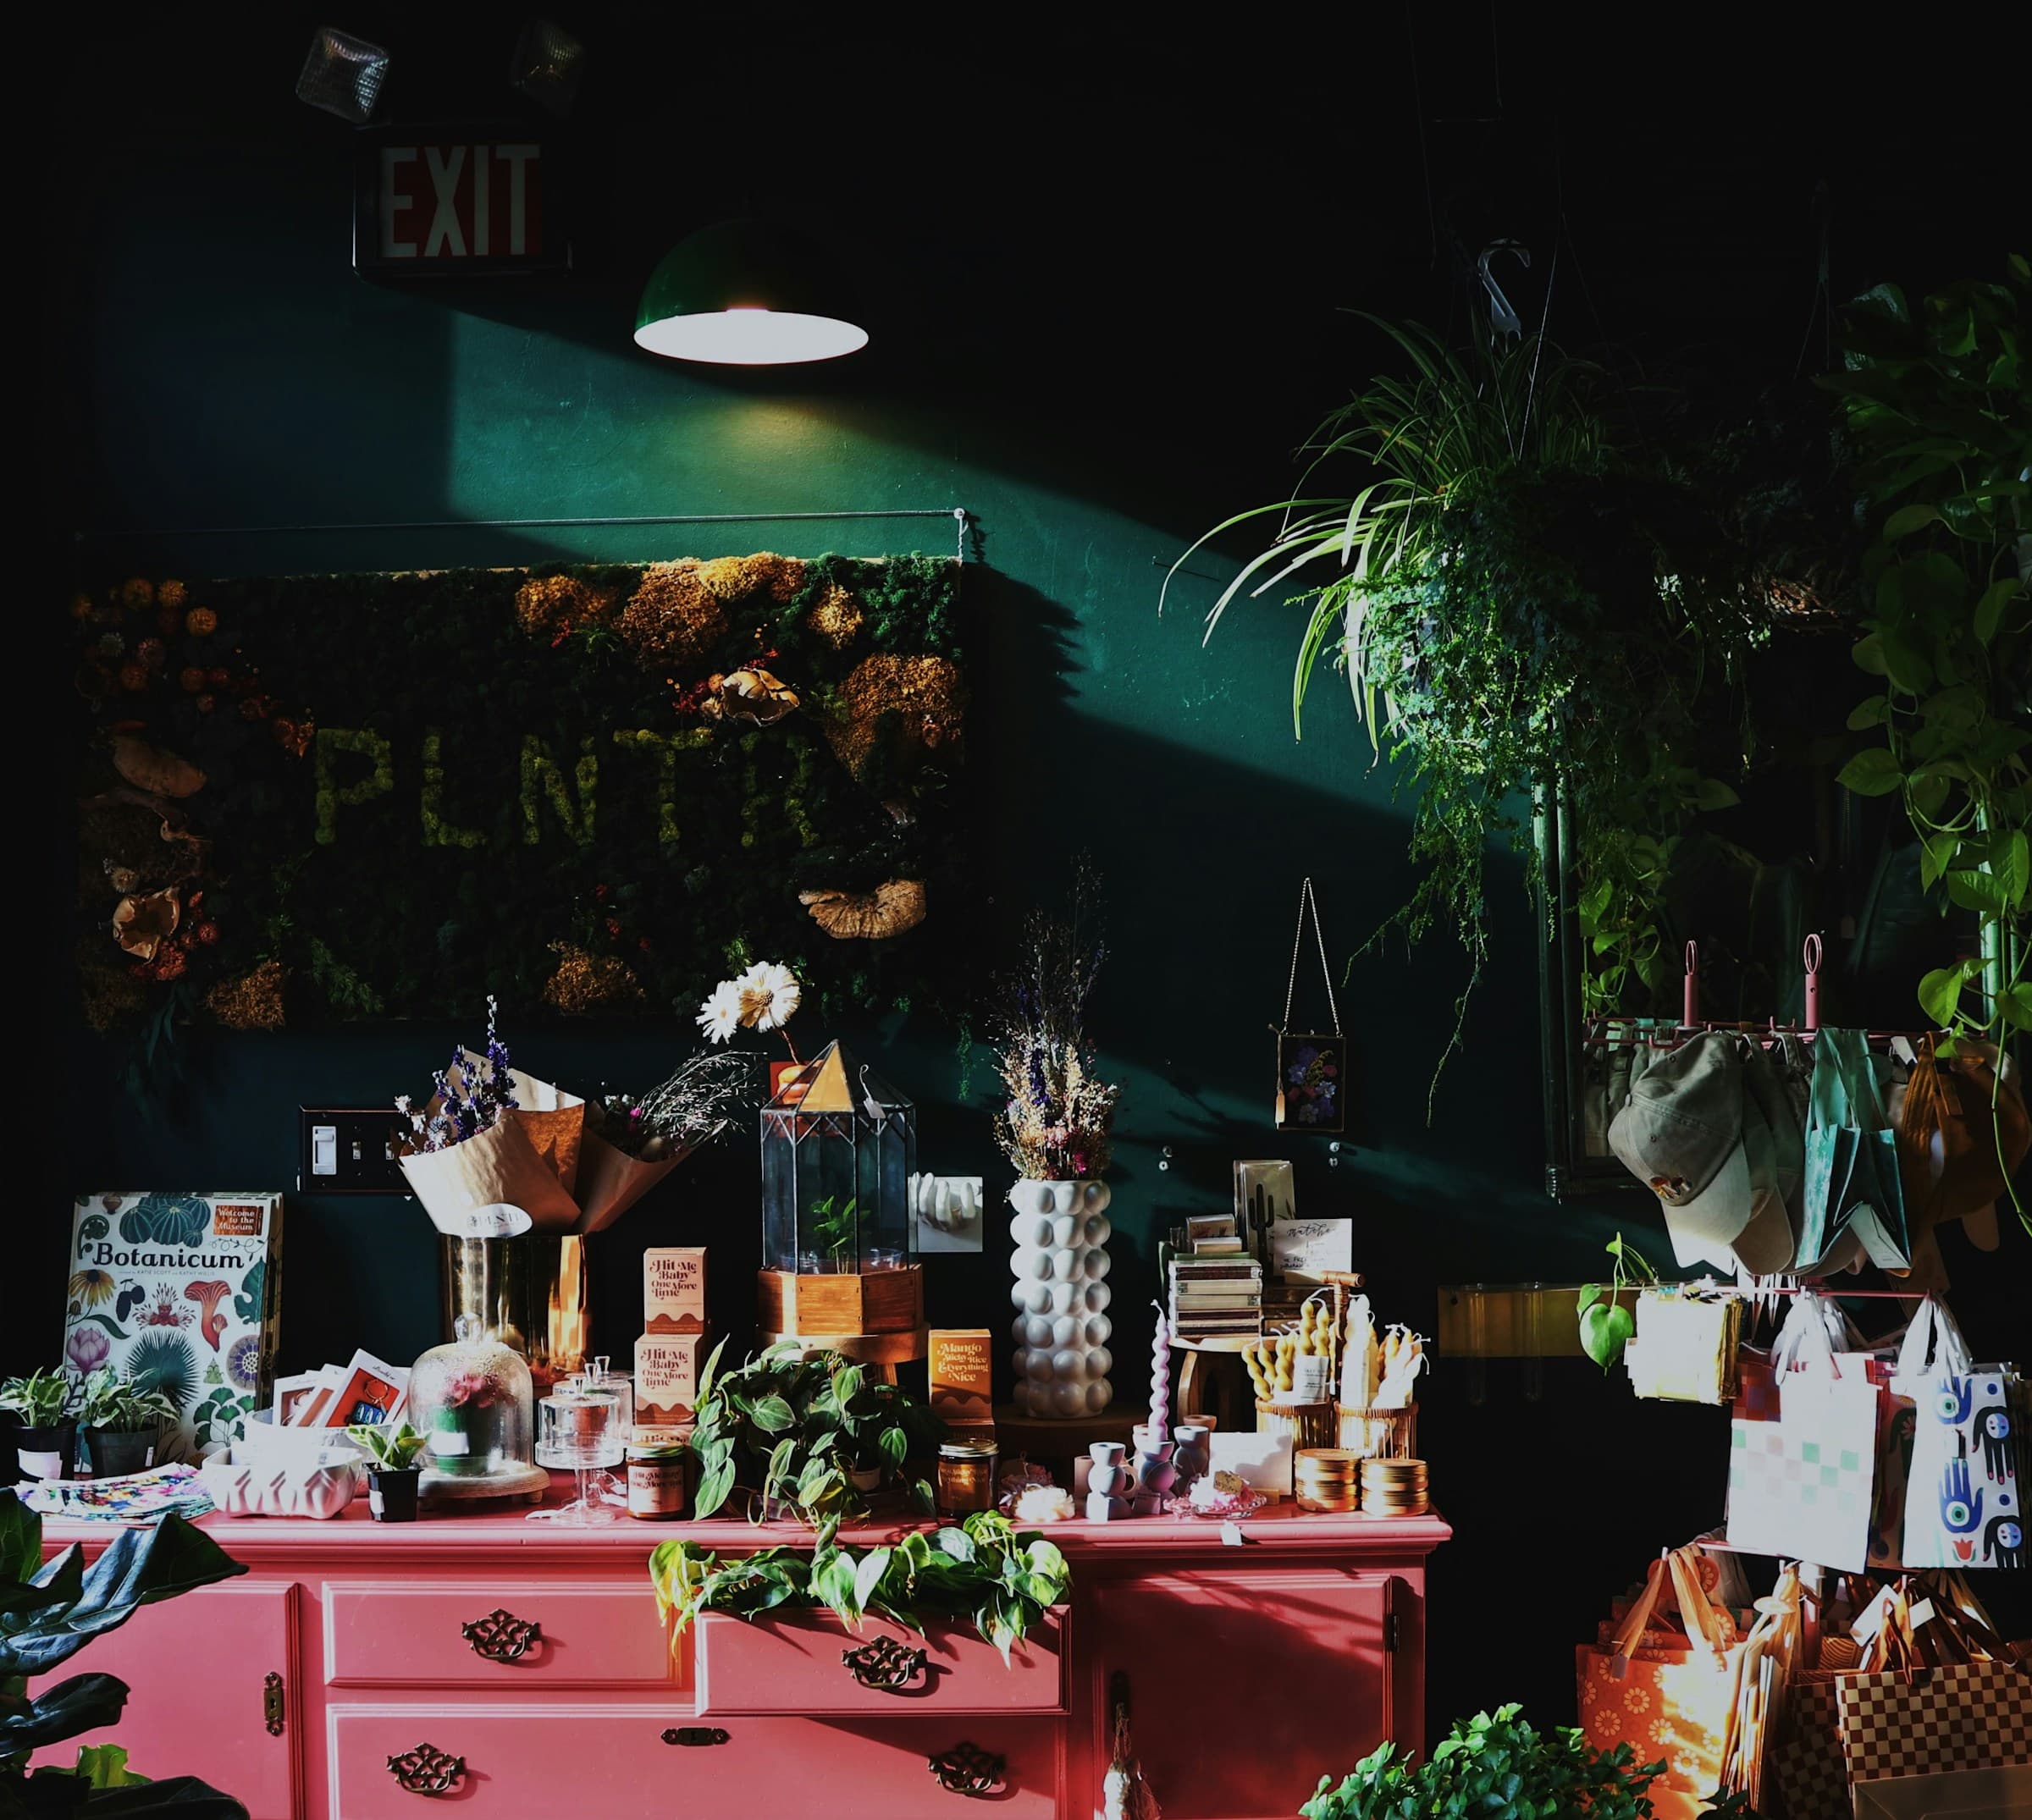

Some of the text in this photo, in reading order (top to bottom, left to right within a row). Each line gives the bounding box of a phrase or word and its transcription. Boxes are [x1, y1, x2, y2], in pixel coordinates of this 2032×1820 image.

[382, 143, 541, 257] EXIT
[218, 1208, 255, 1216] Welcome
[218, 1222, 254, 1230] Museum
[92, 1243, 244, 1268] Botanicum
[649, 1260, 697, 1273] Hit Me
[659, 1271, 690, 1282] Baby
[651, 1288, 680, 1300] Time
[936, 1343, 982, 1355] Mango
[640, 1348, 688, 1363] Hit Me
[650, 1359, 680, 1372] Baby
[947, 1363, 989, 1373] Everything
[948, 1371, 976, 1382] Nice
[643, 1377, 671, 1389] Time
